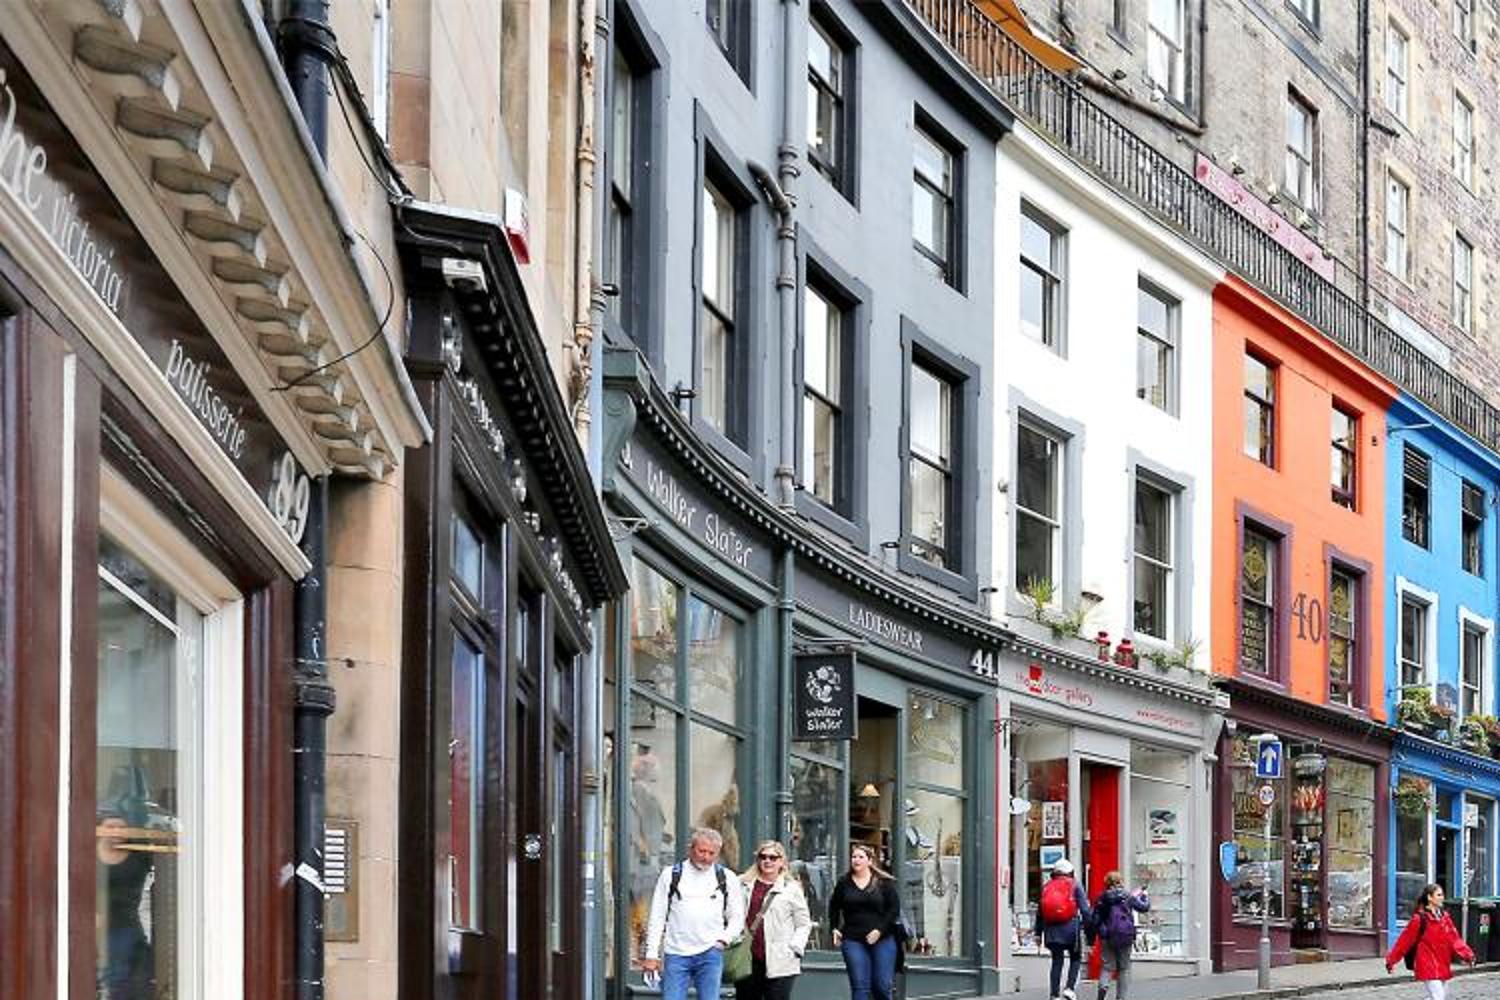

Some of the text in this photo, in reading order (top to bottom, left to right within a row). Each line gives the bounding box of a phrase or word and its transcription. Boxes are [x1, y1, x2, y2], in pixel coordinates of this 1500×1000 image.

[53, 193, 122, 313] victoria
[165, 338, 246, 460] patisserie
[850, 605, 923, 652] LADIESWEAR
